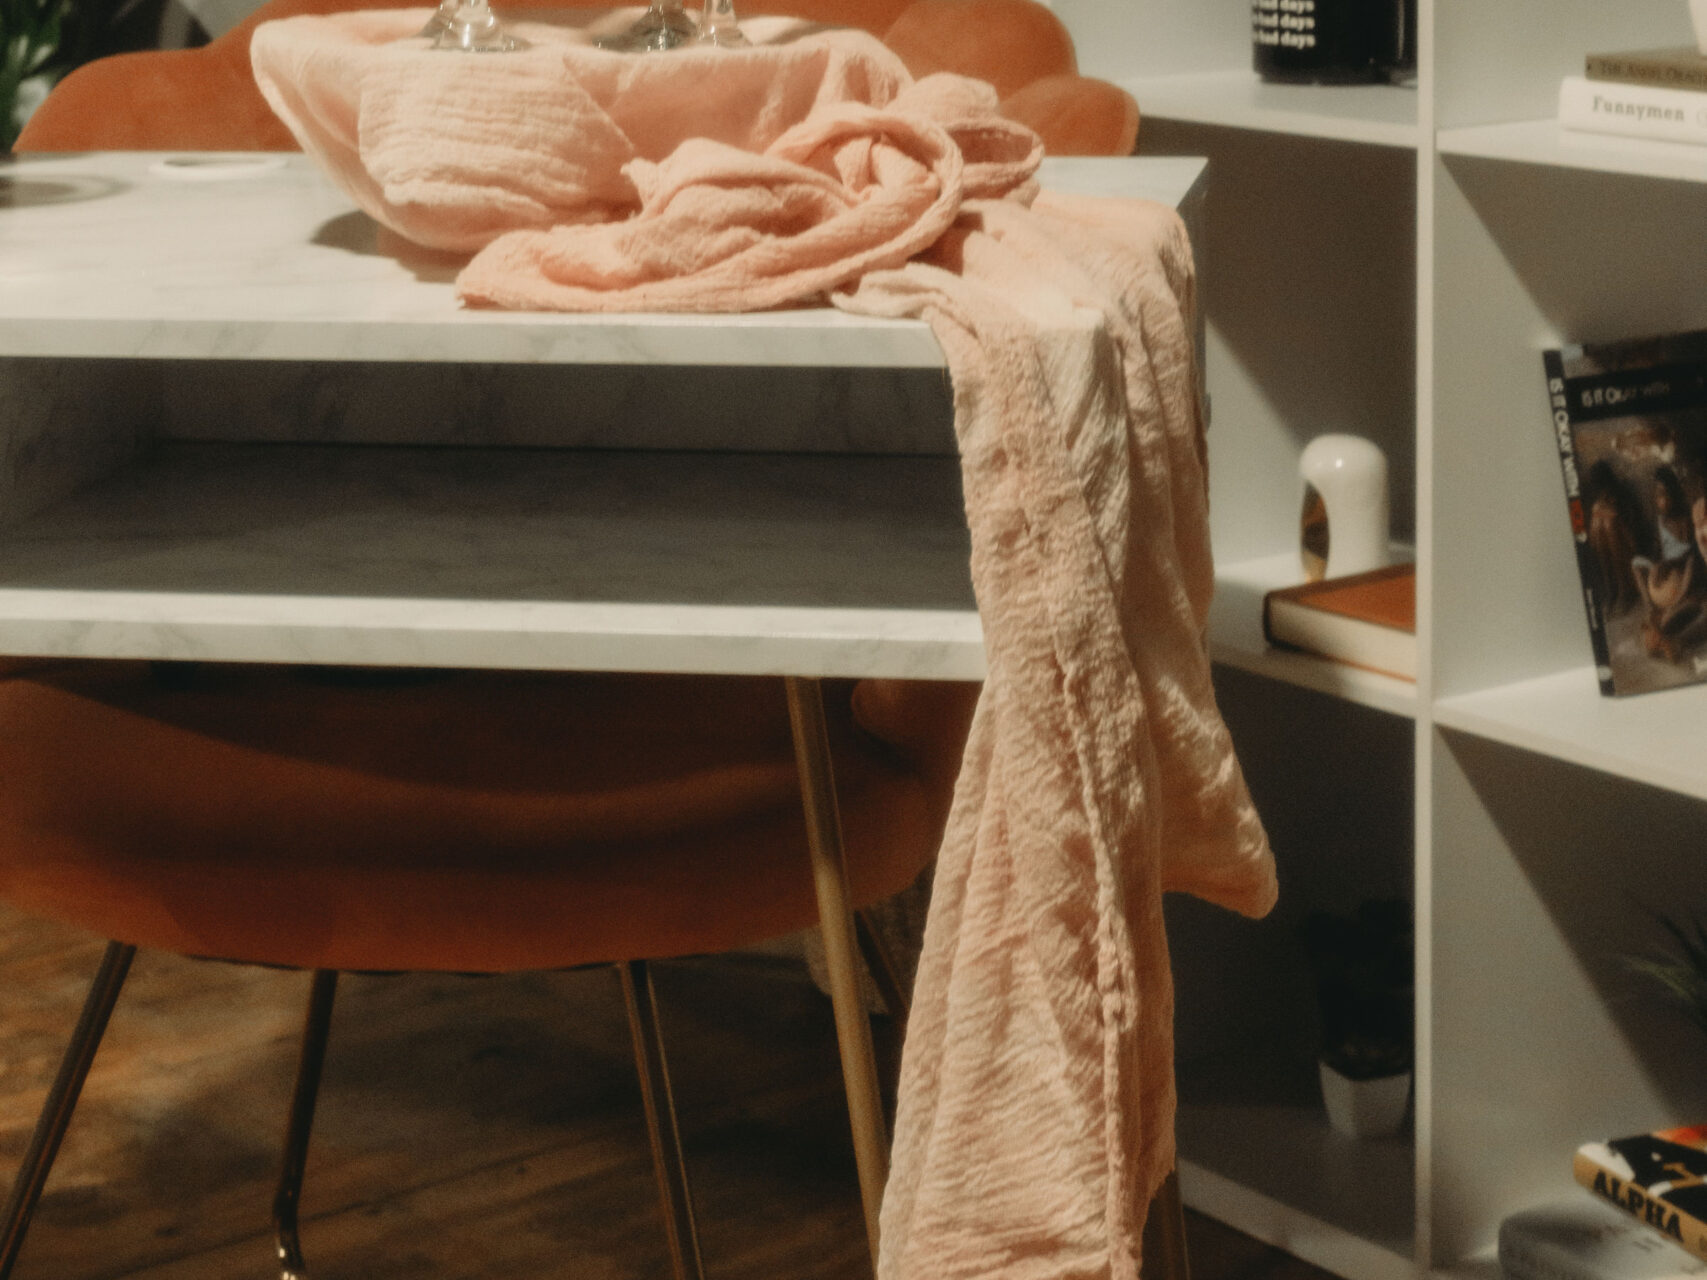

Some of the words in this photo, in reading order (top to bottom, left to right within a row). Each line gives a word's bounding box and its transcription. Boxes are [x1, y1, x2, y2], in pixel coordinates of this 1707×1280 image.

[1280, 13, 1316, 32] days
[1280, 31, 1316, 50] days
[1593, 94, 1685, 121] Funnymen
[1555, 409, 1573, 453] OKAY
[1593, 1168, 1685, 1243] ALPHA
